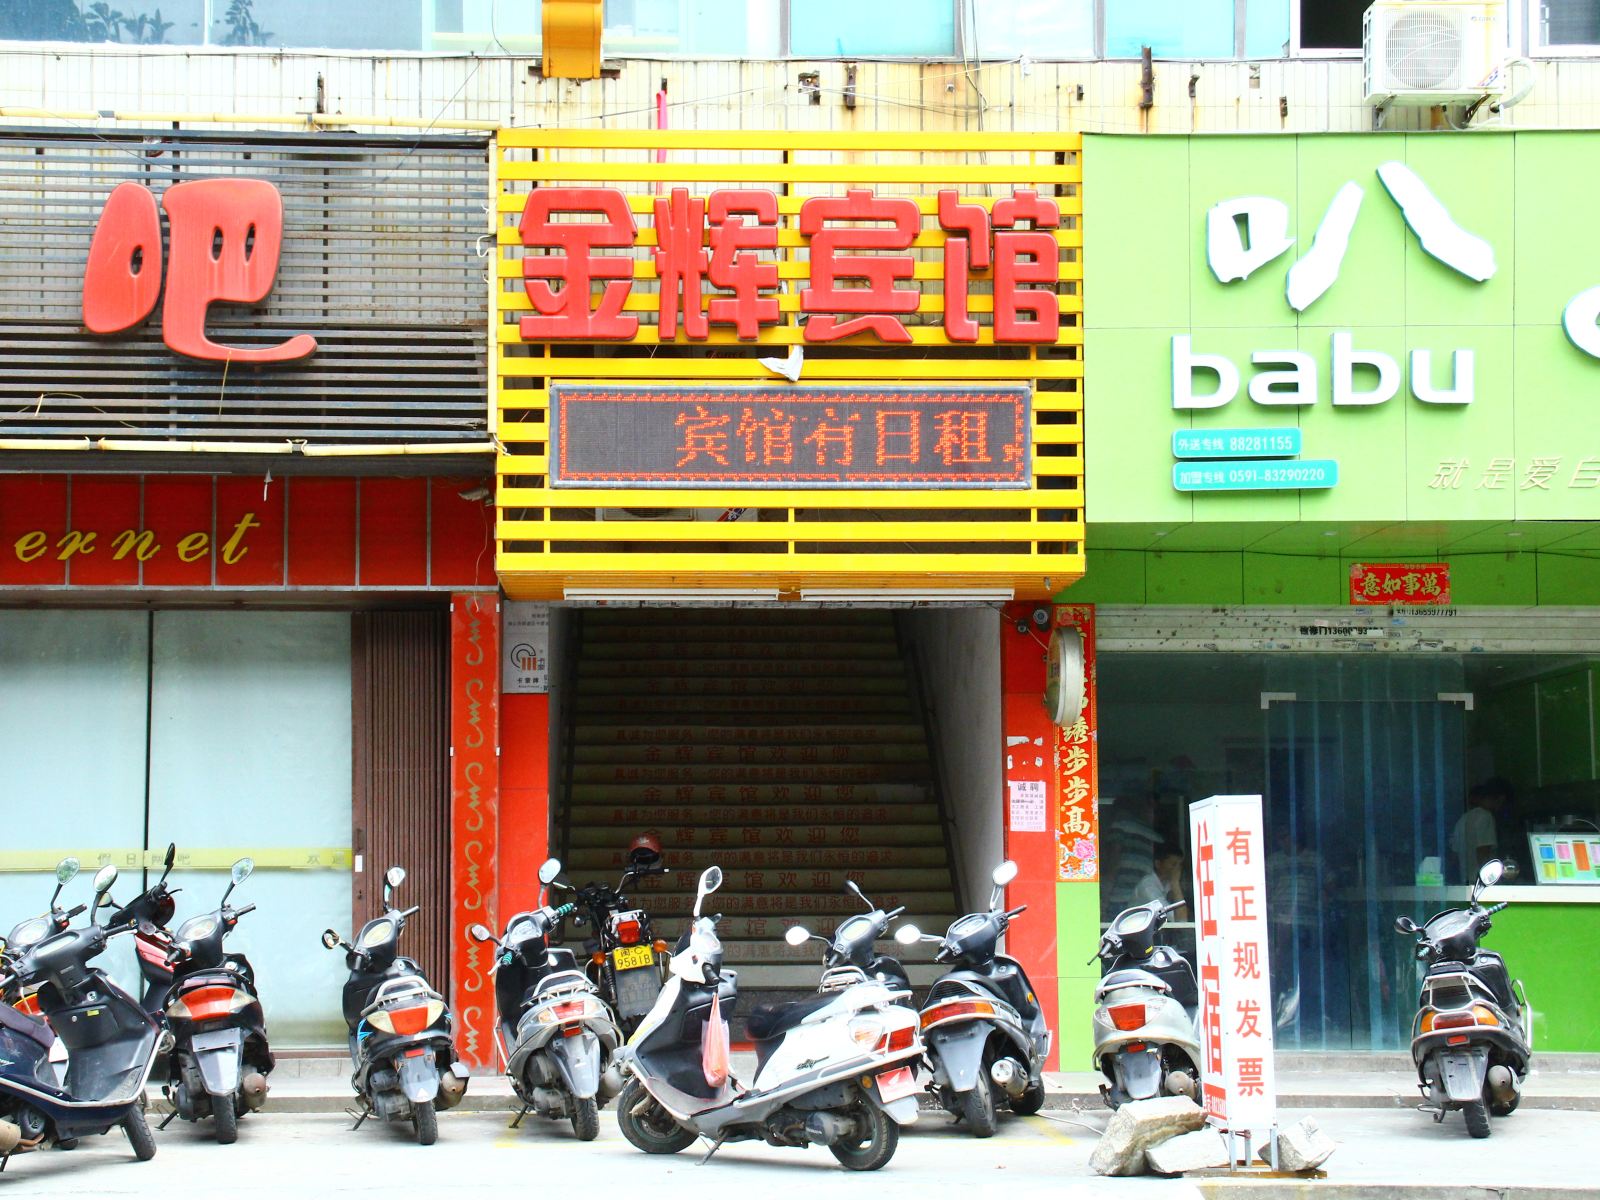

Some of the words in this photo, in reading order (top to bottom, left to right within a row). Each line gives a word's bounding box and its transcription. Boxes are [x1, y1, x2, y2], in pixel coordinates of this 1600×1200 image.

[82, 178, 319, 363] 吧
[518, 187, 1061, 345] 金辉宾馆
[1171, 332, 1476, 409] babu
[1178, 437, 1225, 452] 外送专线
[1229, 435, 1293, 452] 88281155
[1229, 468, 1325, 483] 0591-83290220
[1196, 819, 1224, 1078] 住宿
[1225, 827, 1265, 1098] 有正规发票
